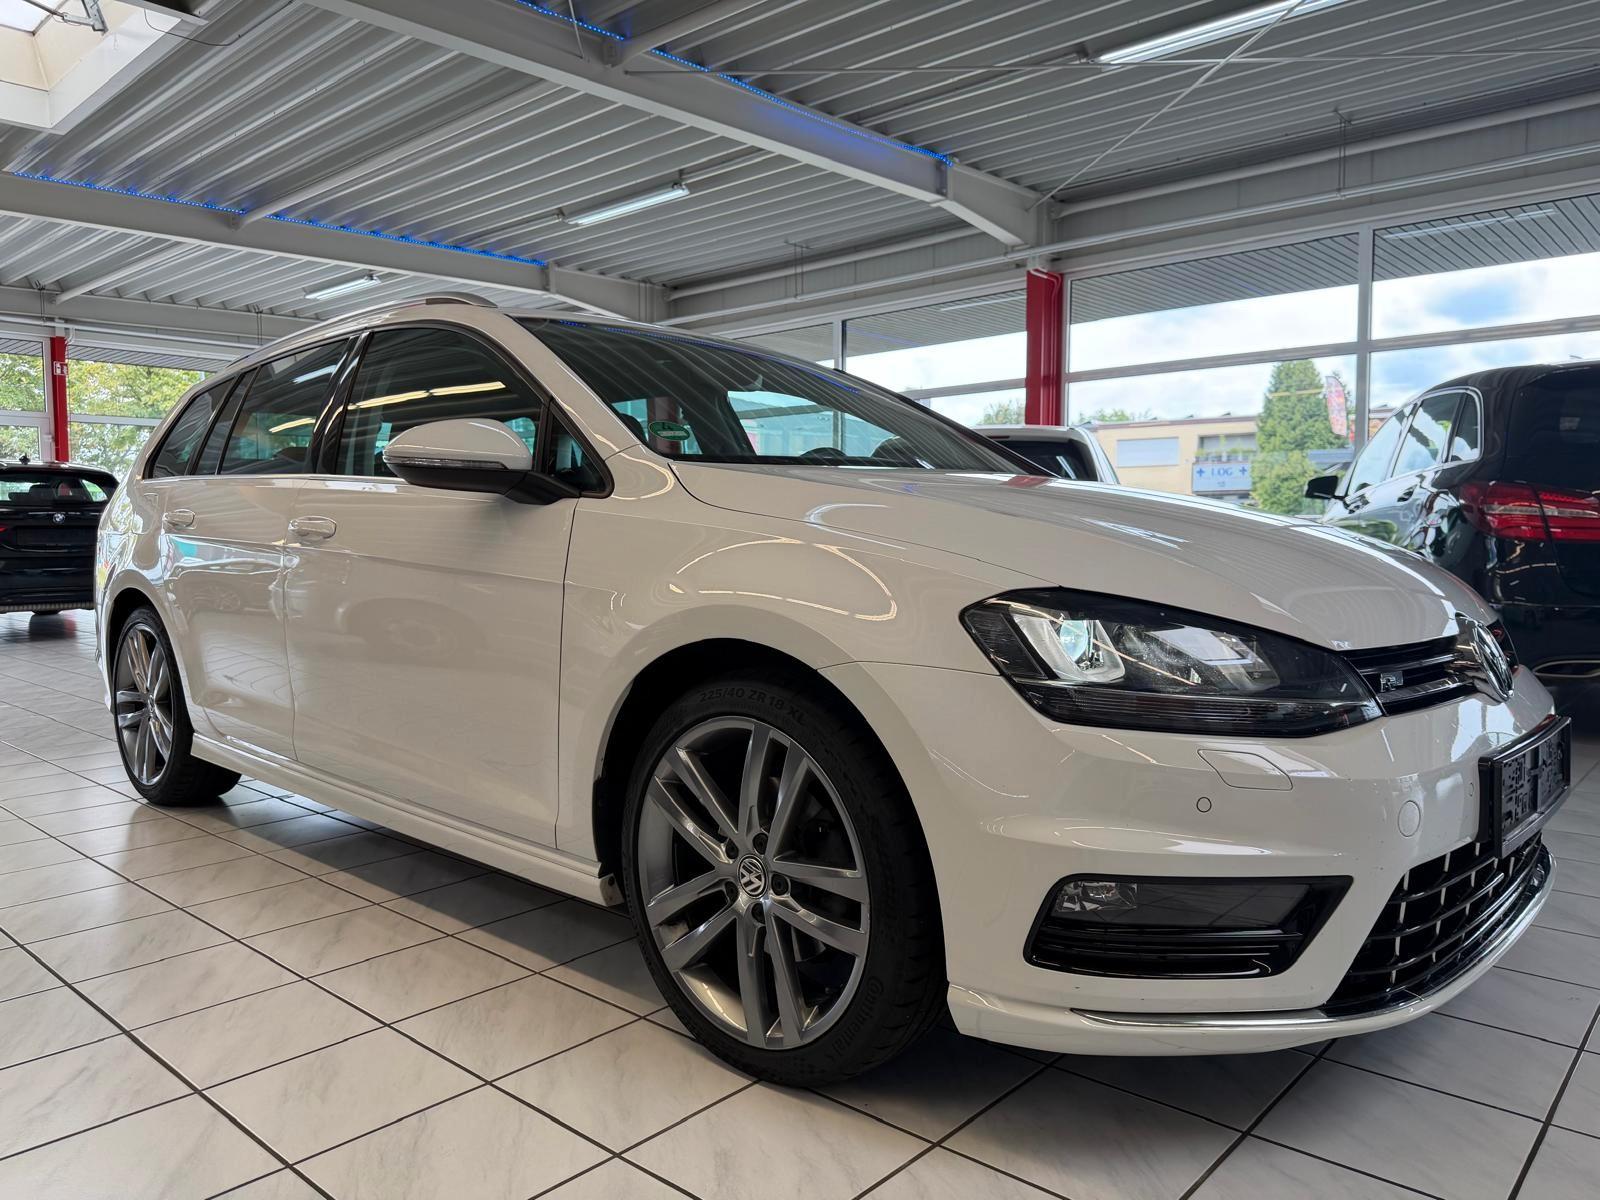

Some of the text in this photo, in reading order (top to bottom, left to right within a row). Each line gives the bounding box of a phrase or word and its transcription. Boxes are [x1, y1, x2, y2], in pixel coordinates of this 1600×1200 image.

[699, 687, 808, 727] 225/40 ZR 18 XL
